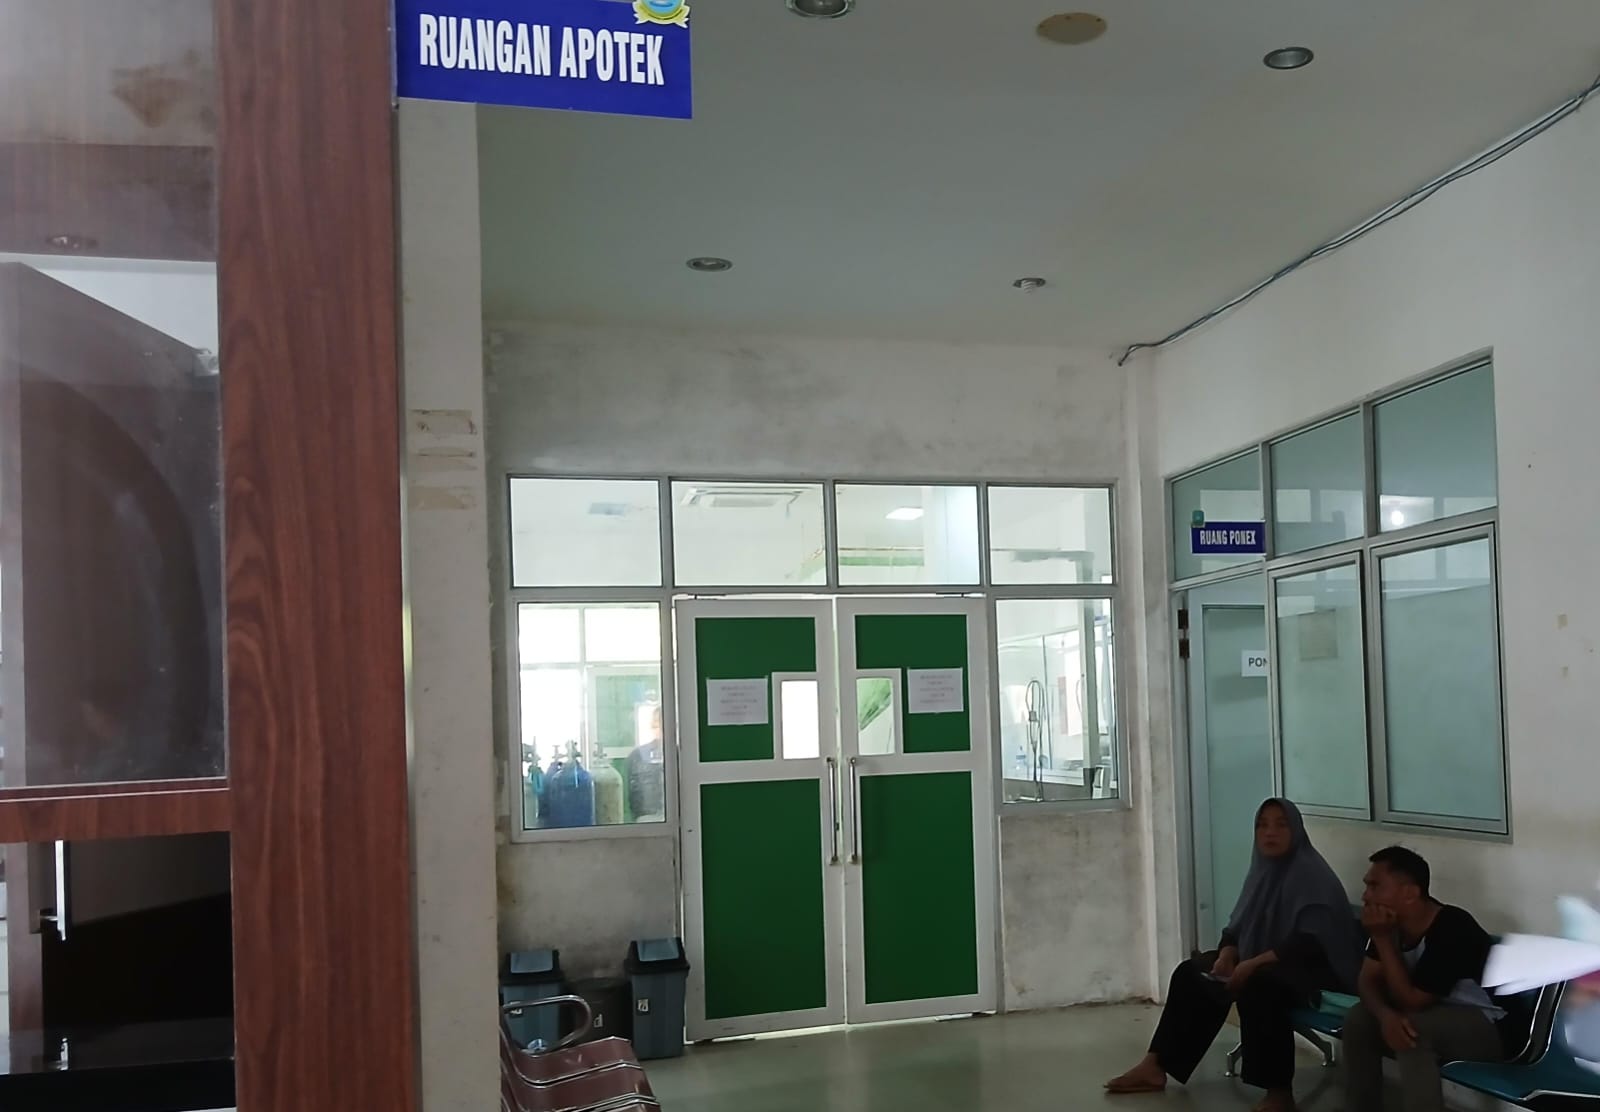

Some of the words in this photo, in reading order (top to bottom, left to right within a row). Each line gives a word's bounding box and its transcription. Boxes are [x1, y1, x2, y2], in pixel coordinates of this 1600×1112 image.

[419, 13, 551, 76] RUANGAN
[559, 26, 665, 86] APOTEK
[1200, 530, 1227, 545] RUANG
